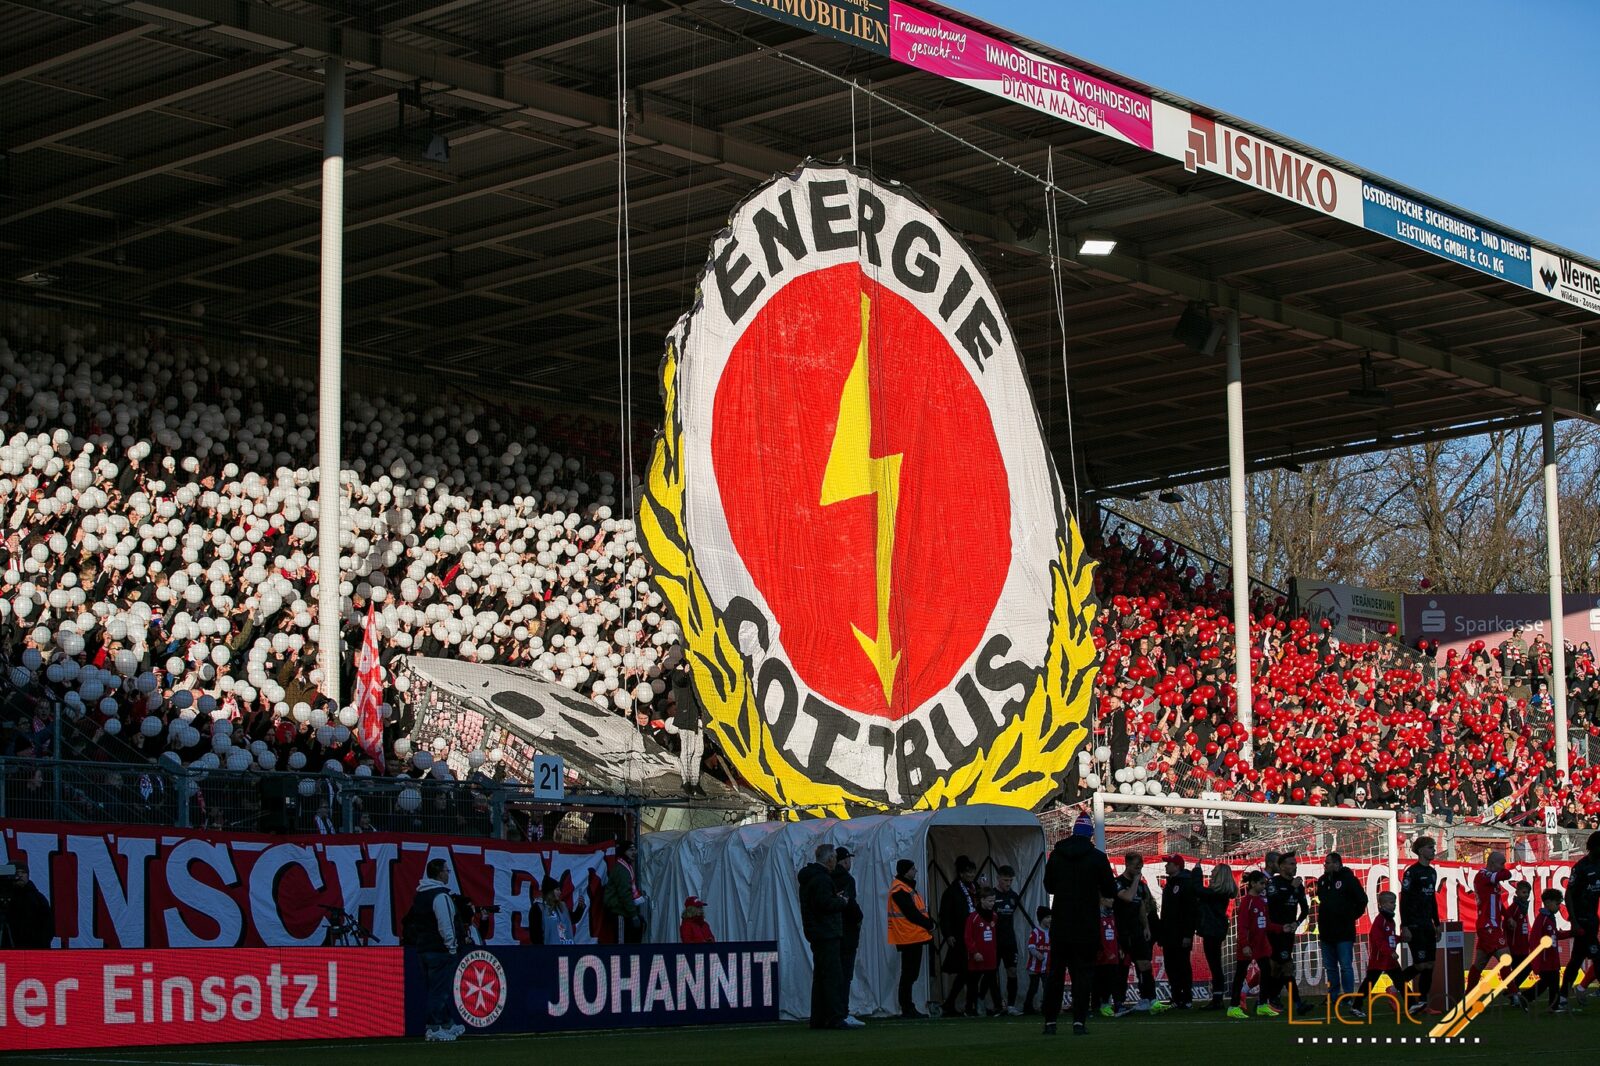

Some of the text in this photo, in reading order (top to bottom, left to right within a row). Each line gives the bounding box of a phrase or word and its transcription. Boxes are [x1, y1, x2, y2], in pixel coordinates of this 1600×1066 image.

[893, 13, 967, 52] Traumwohnung
[986, 44, 1150, 121] IMMOBILIEN & WOHNDESIGN
[1002, 74, 1105, 130] DIANA MAASCH
[1224, 130, 1338, 213] ISIMKO
[1363, 185, 1531, 261] OSTDEUTSCHE SICHERHEITS- UND DIENST-
[1396, 220, 1504, 274] LEISTUNGS GMBH & CO. KG
[714, 179, 1004, 374] ENERGIE
[1352, 593, 1395, 612] VERÄNDERUNG
[1454, 615, 1544, 635] Sparkasse
[539, 762, 559, 791] 21
[1546, 811, 1556, 829] 23
[103, 961, 338, 1025] Einsatz!
[547, 951, 778, 1017] JOHANNIT
